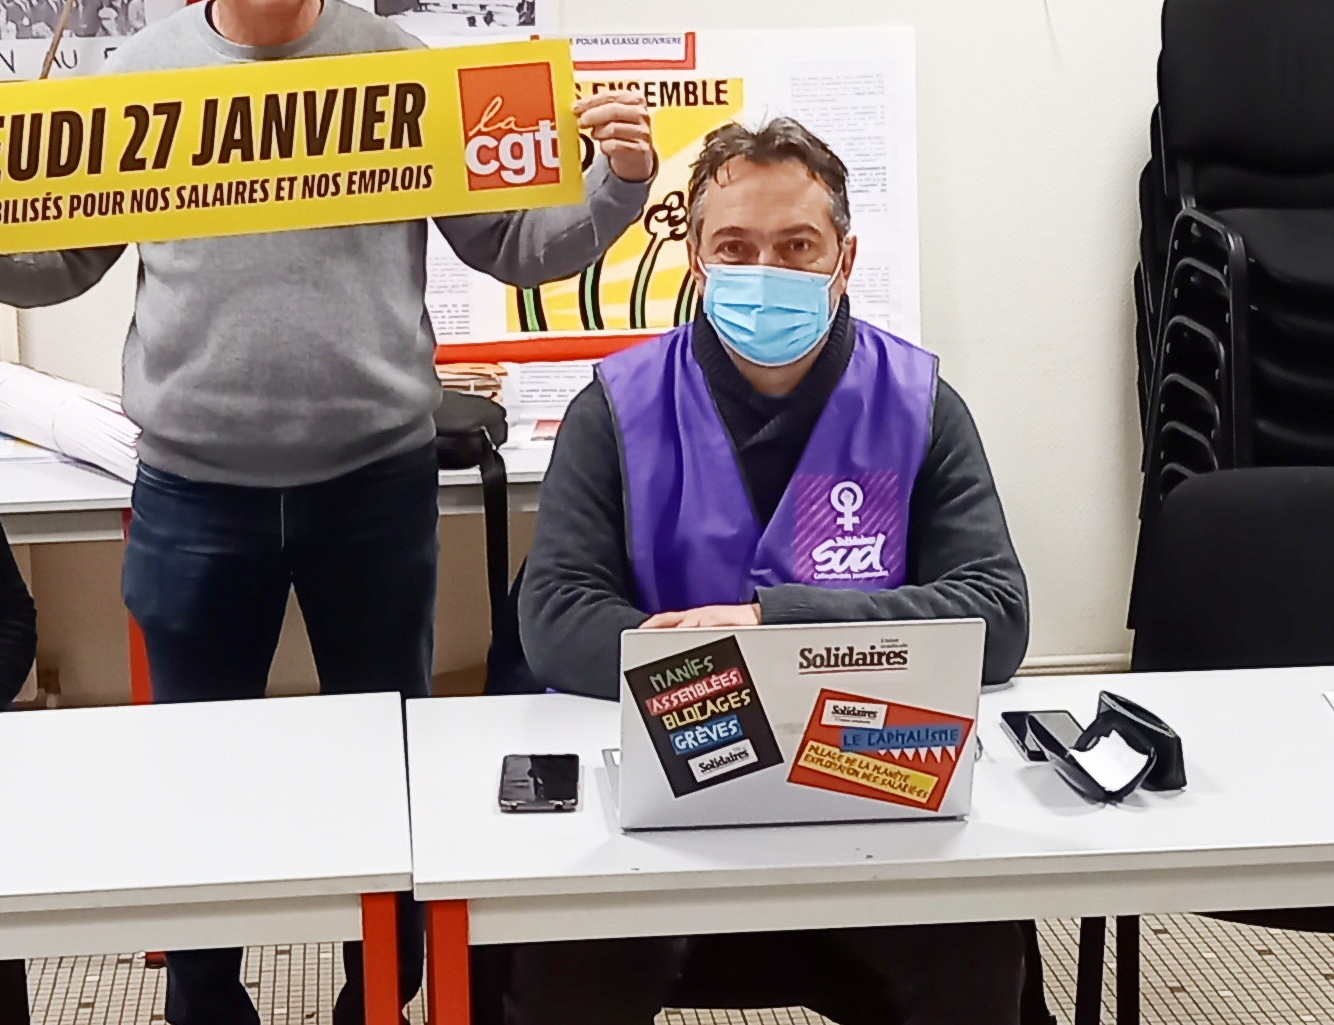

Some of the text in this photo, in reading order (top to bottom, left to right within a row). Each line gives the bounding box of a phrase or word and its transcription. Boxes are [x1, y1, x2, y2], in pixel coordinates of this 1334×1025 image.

[612, 37, 639, 45] CLASSE
[119, 101, 183, 172] 27
[192, 82, 426, 166] JANVIER
[465, 119, 559, 184] cgt
[68, 191, 124, 219] POUR
[130, 187, 170, 213] NOS
[176, 178, 270, 210] SALAIRES
[275, 177, 298, 201] ET
[301, 172, 341, 199] NOS
[346, 165, 434, 195] EMPLOIS
[650, 655, 714, 692] MANIFS
[799, 645, 908, 669] Solidaires
[651, 670, 738, 712] ASSEMBLÉES
[662, 689, 751, 730] BLOCAGES
[831, 704, 878, 719] Solidaires
[674, 720, 738, 750] GRÈVES
[843, 734, 861, 746] LE
[698, 748, 750, 773] Solidaires
